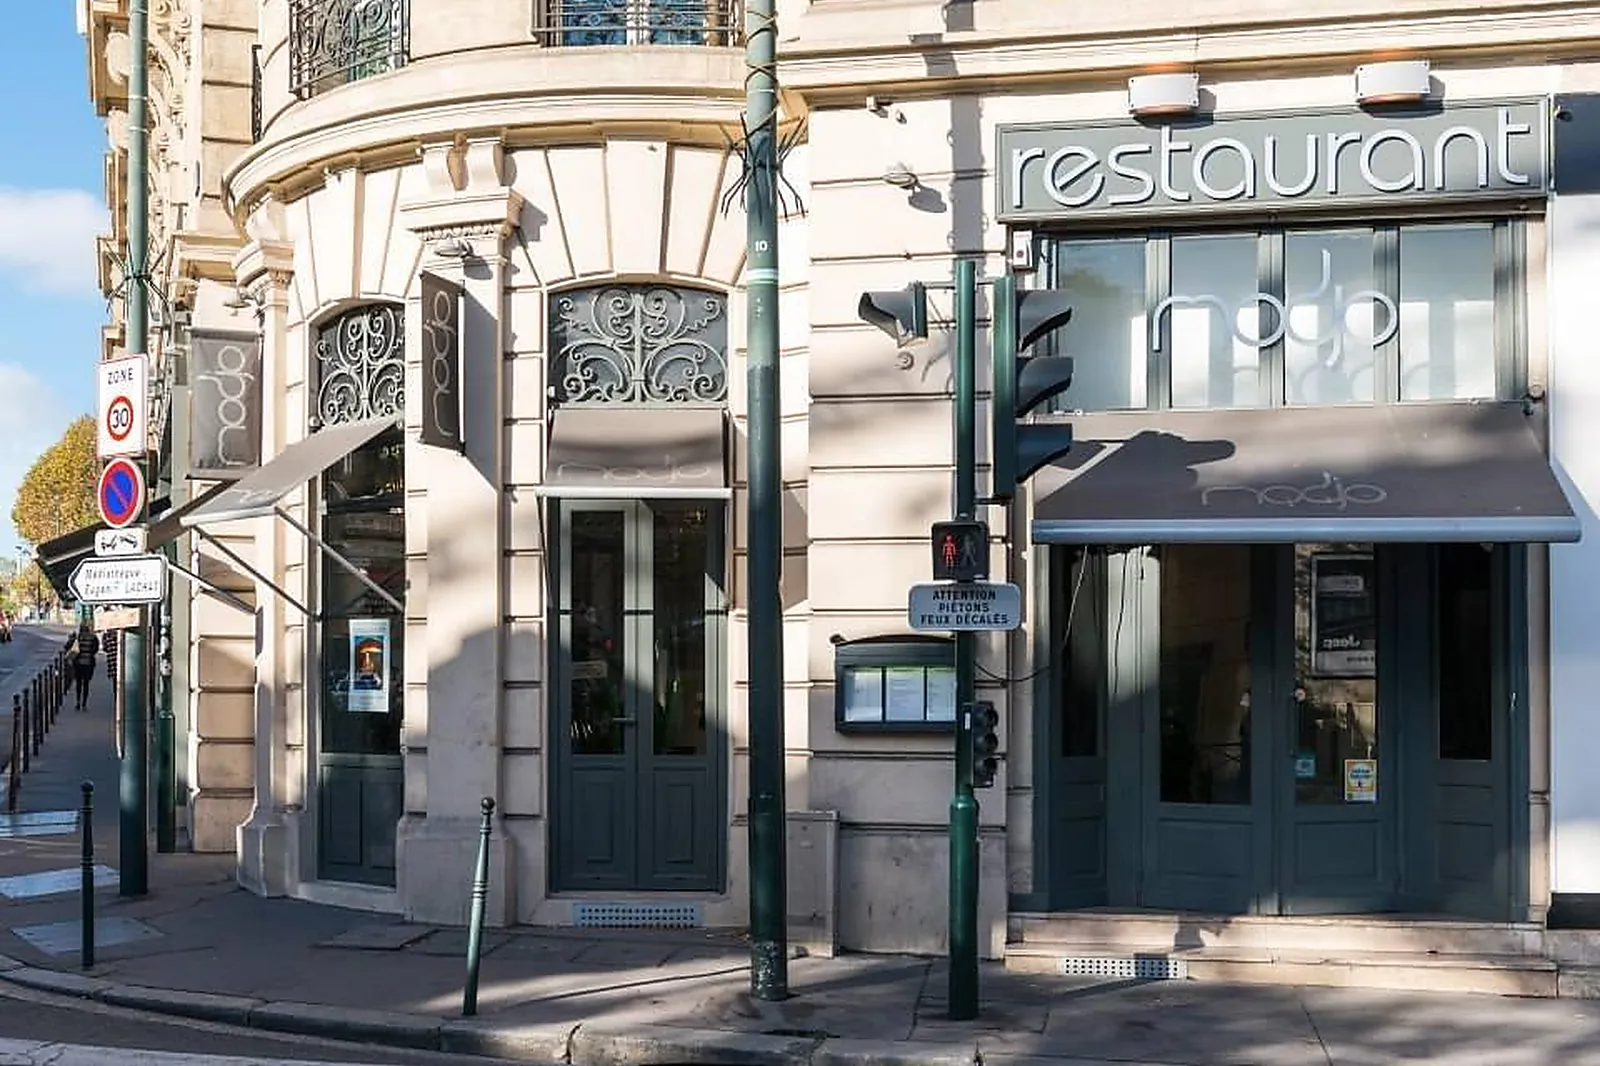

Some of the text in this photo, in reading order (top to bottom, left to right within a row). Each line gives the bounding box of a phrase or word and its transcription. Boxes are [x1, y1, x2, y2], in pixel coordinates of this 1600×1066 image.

[1012, 108, 1531, 208] restaurant
[755, 239, 768, 252] 10
[108, 367, 134, 385] ZONE
[112, 407, 130, 429] 30
[933, 590, 996, 601] ATTENTION
[920, 614, 950, 625] FEUX
